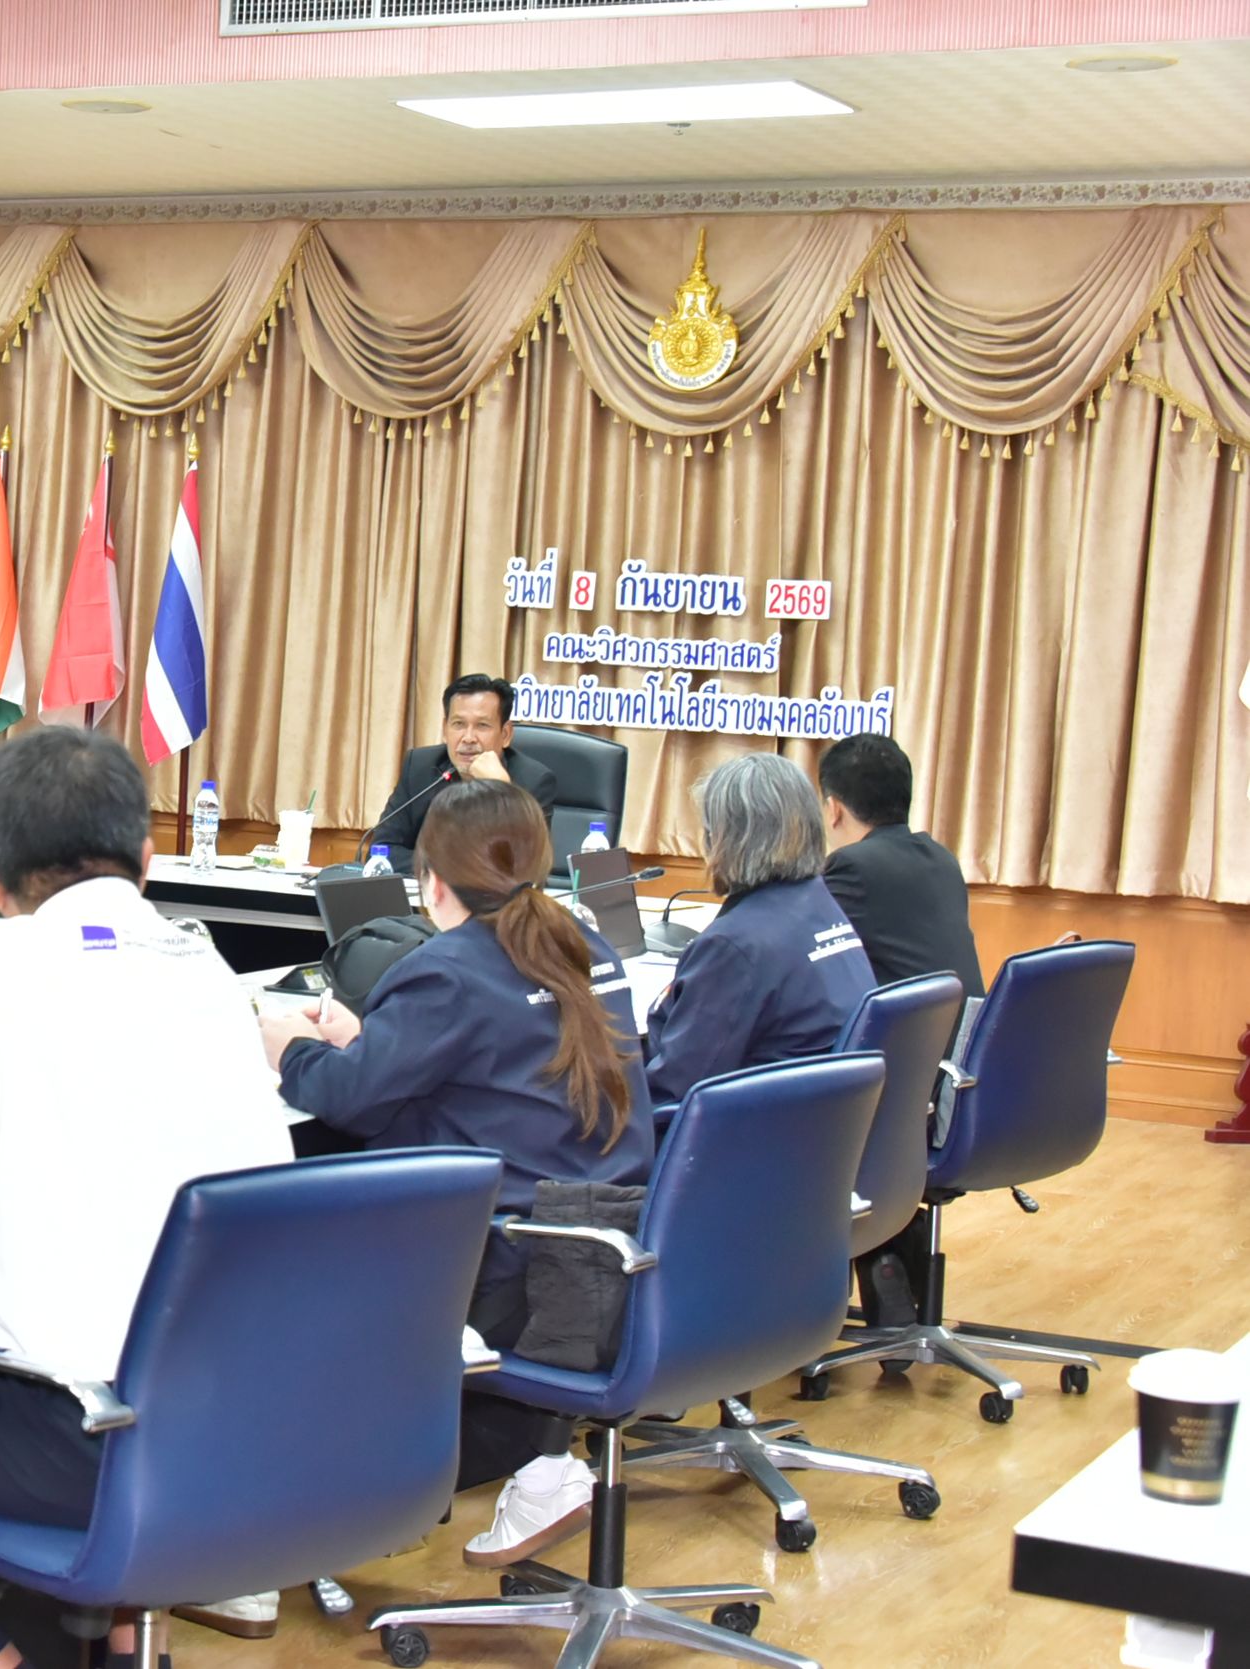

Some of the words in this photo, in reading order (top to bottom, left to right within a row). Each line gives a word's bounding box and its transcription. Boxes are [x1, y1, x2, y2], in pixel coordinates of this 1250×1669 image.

[507, 552, 554, 603] วันที่
[574, 576, 591, 606] 8
[620, 563, 742, 612] กันยายน
[768, 583, 827, 616] 2569
[546, 628, 778, 670] คณะวิศวกรรมศาสตร์
